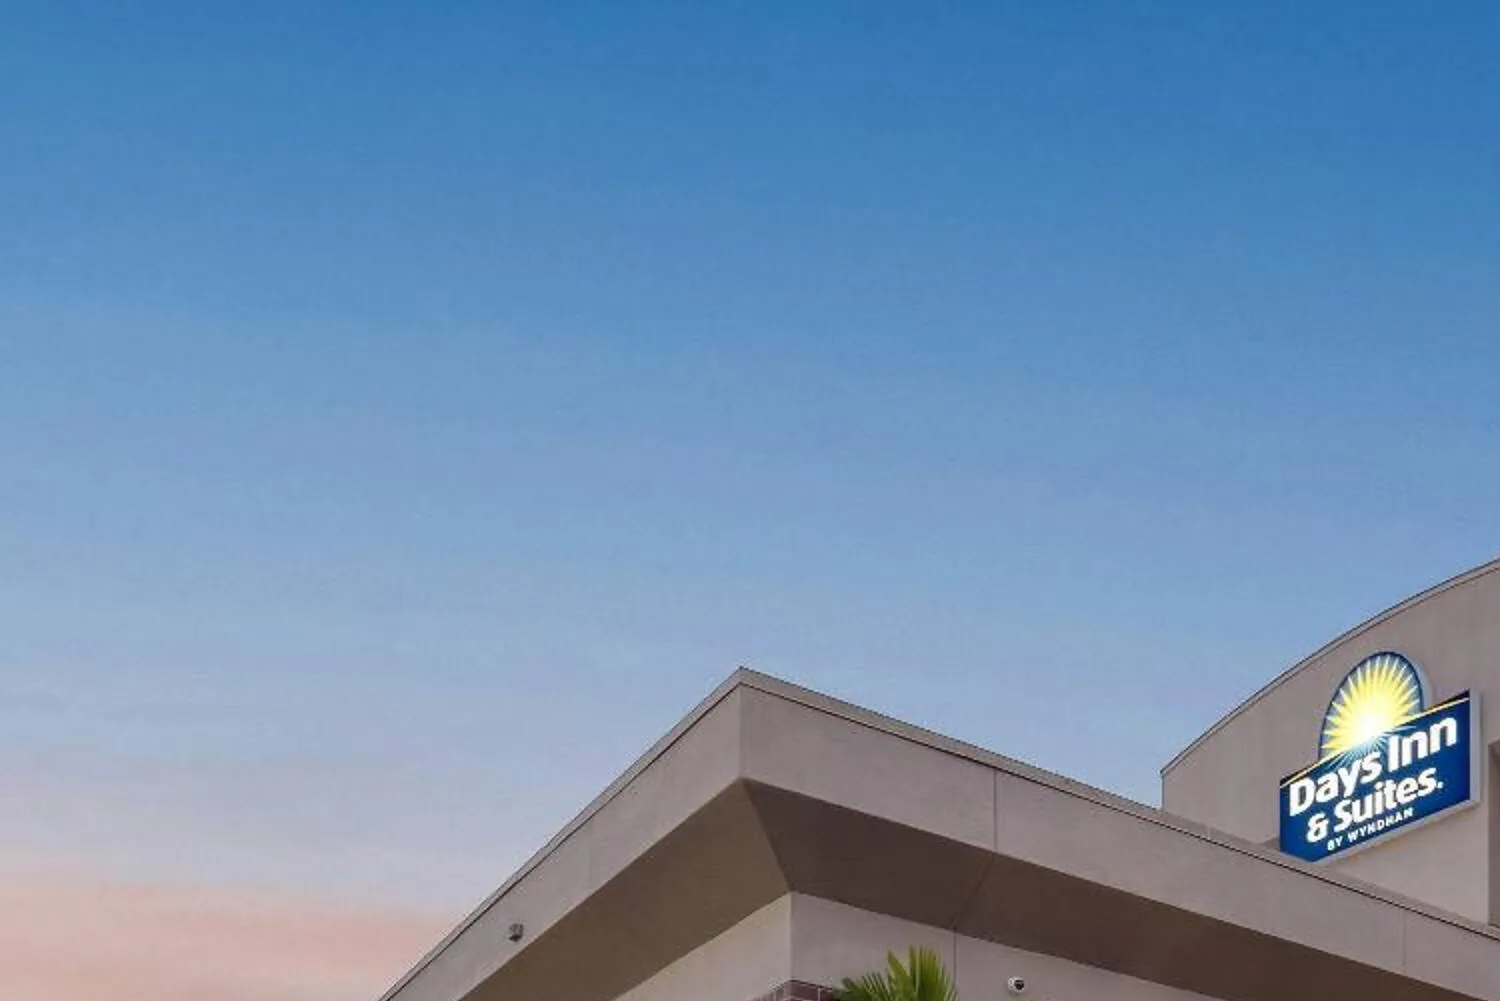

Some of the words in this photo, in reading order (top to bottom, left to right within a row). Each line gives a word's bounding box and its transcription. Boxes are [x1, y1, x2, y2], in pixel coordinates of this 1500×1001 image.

[1289, 751, 1382, 817] Days
[1388, 717, 1457, 773] Inn
[1306, 813, 1330, 843] &
[1327, 836, 1343, 851] BY
[1348, 807, 1414, 842] WYNDHAM
